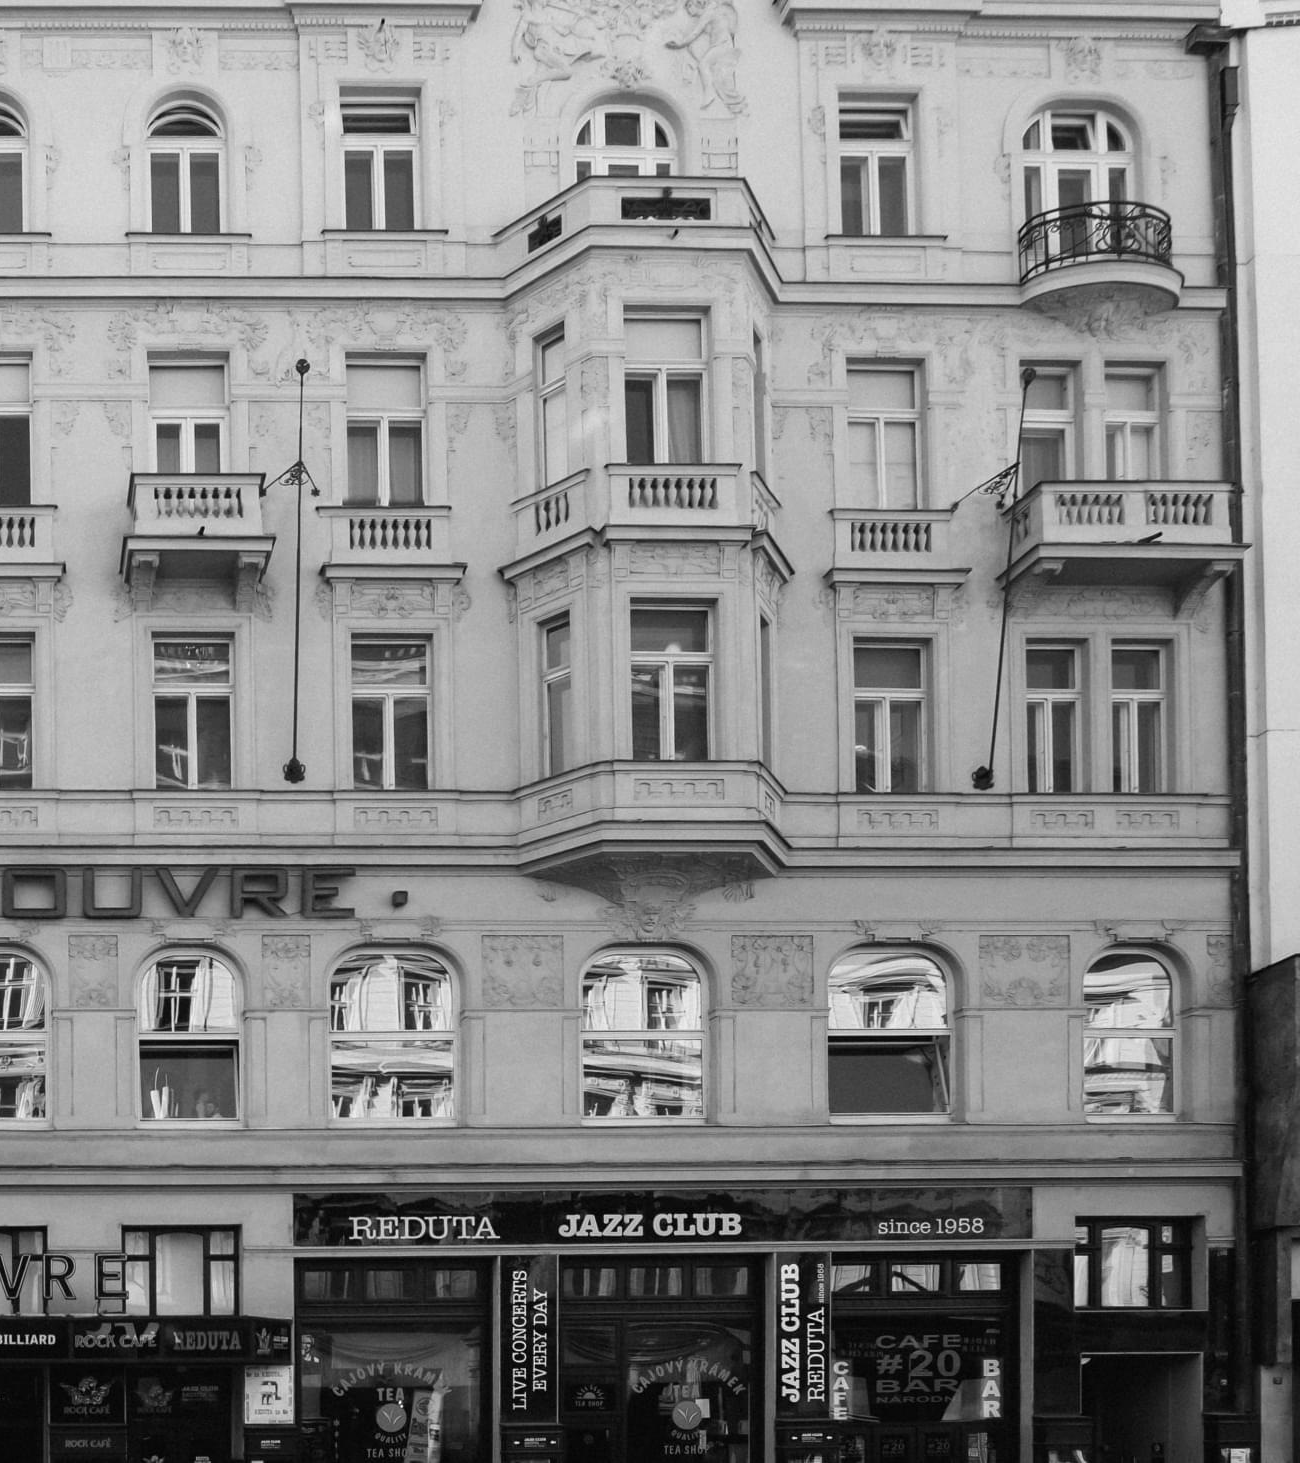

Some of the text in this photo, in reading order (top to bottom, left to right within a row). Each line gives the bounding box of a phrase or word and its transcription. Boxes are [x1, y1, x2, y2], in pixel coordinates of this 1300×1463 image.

[348, 1216, 500, 1240] REDUTA
[558, 1213, 743, 1238] JAZZ CLUB
[878, 1218, 985, 1235] since 1958
[781, 1263, 800, 1332] CLUB
[74, 1331, 157, 1348] ROCK CAFÉ
[173, 1331, 242, 1350] REDUTA
[512, 1270, 528, 1411] LIVE CONCERTS
[532, 1287, 548, 1392] EVERY DAY
[875, 1334, 962, 1349] CAFE
[806, 1306, 825, 1402] REDUTA
[875, 1349, 962, 1377] #20
[781, 1338, 800, 1403] JAZZ
[376, 1387, 405, 1402] TEA
[673, 1384, 700, 1400] TEA
[832, 1361, 850, 1420] CAFE
[875, 1379, 960, 1393] BAR
[981, 1359, 1002, 1418] BAR
[63, 1406, 88, 1415] ROCK
[65, 1439, 88, 1448] ROCK
[374, 1432, 407, 1444] QUALITY
[366, 1448, 410, 1458] TEA SHO
[663, 1445, 709, 1456] TEA SHOP
